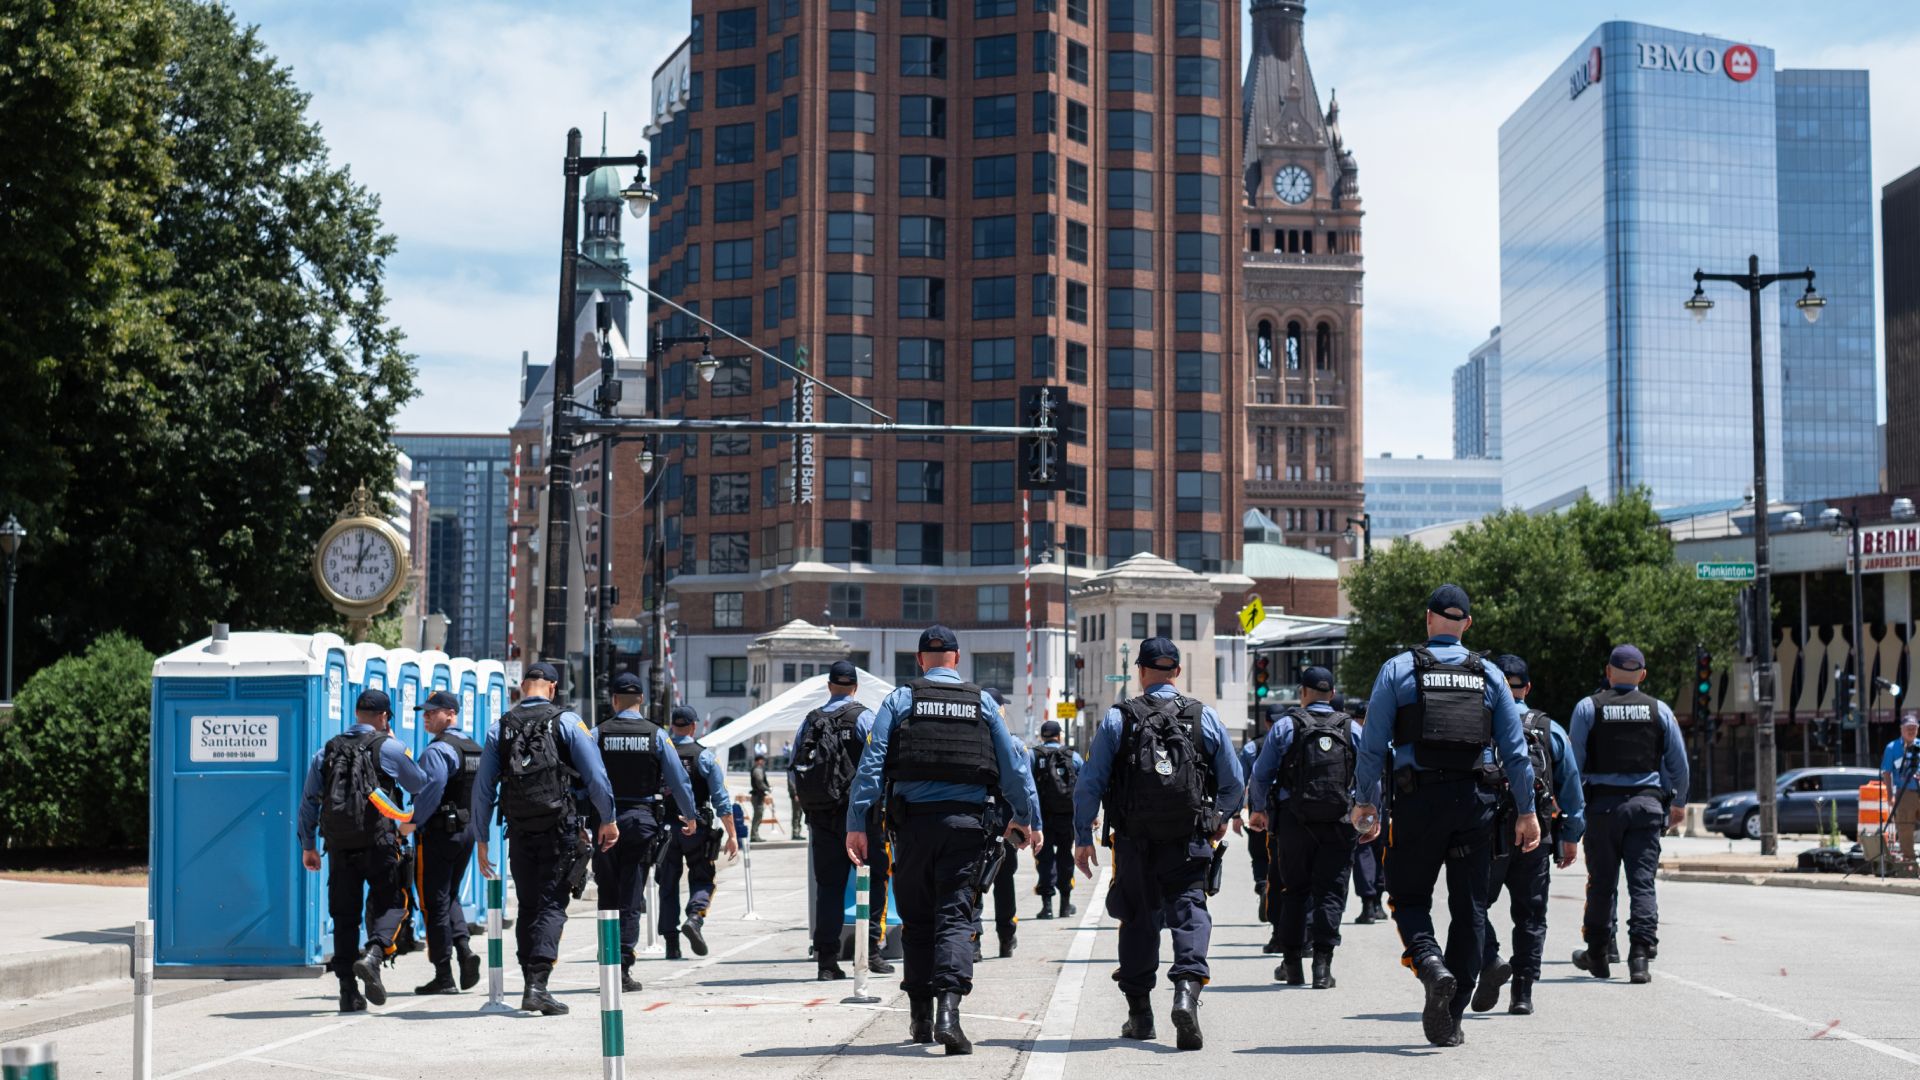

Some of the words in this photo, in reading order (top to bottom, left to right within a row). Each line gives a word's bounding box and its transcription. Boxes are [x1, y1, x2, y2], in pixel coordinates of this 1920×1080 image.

[1638, 43, 1721, 74] BMO
[801, 378, 815, 465] Assocted
[801, 466, 816, 504] Bank
[340, 566, 380, 575] JEWELER
[1702, 565, 1747, 577] Plankinton
[1865, 556, 1903, 570] JAPANESE
[1422, 673, 1452, 687] STATE
[1452, 674, 1485, 690] POLICE
[916, 701, 945, 716] STATE
[945, 702, 977, 718] POLICE
[1603, 705, 1625, 720] STATE
[1625, 704, 1651, 720] POLICE
[201, 719, 268, 736] Service
[200, 736, 268, 748] Sanitation
[604, 736, 625, 751] STATE
[625, 736, 650, 751] POLICE
